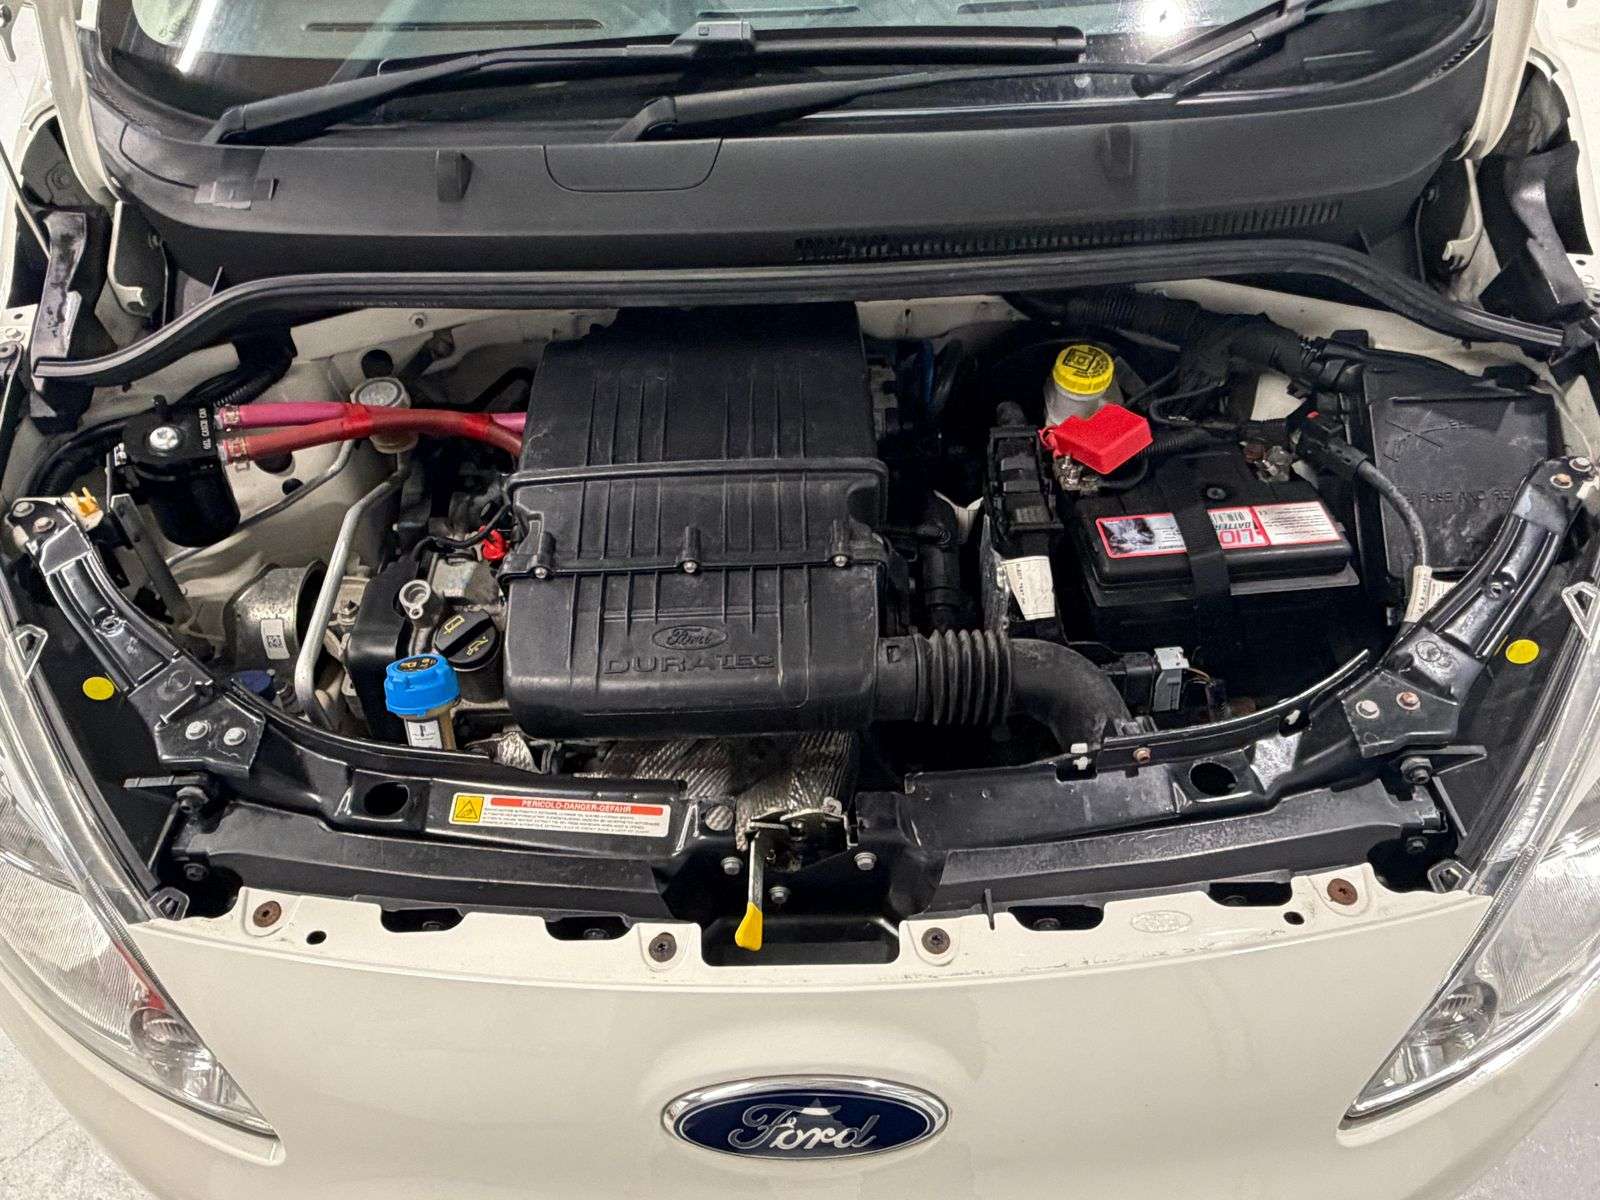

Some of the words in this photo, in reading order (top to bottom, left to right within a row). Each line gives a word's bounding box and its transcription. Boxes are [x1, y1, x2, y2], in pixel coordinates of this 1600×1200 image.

[667, 627, 712, 646] Ford
[603, 653, 776, 675] DURATEC
[727, 1103, 880, 1150] Ford
